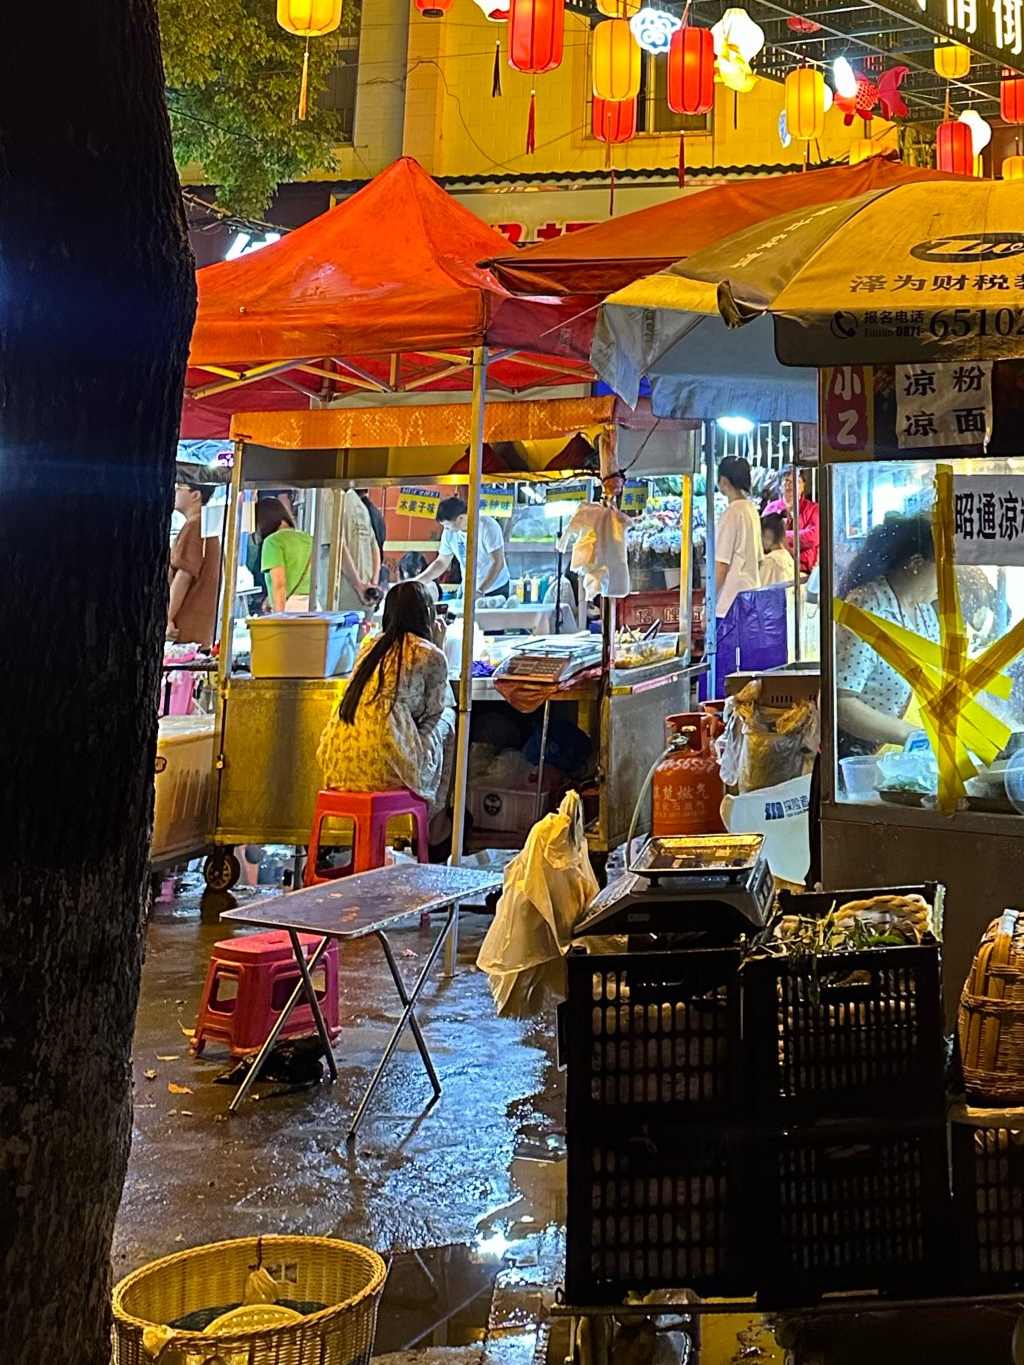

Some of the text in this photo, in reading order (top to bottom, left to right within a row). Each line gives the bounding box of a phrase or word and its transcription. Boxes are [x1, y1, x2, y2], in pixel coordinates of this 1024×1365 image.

[864, 309, 925, 324] 报名电话
[904, 365, 986, 397] 凉粉
[904, 406, 986, 437] 凉面
